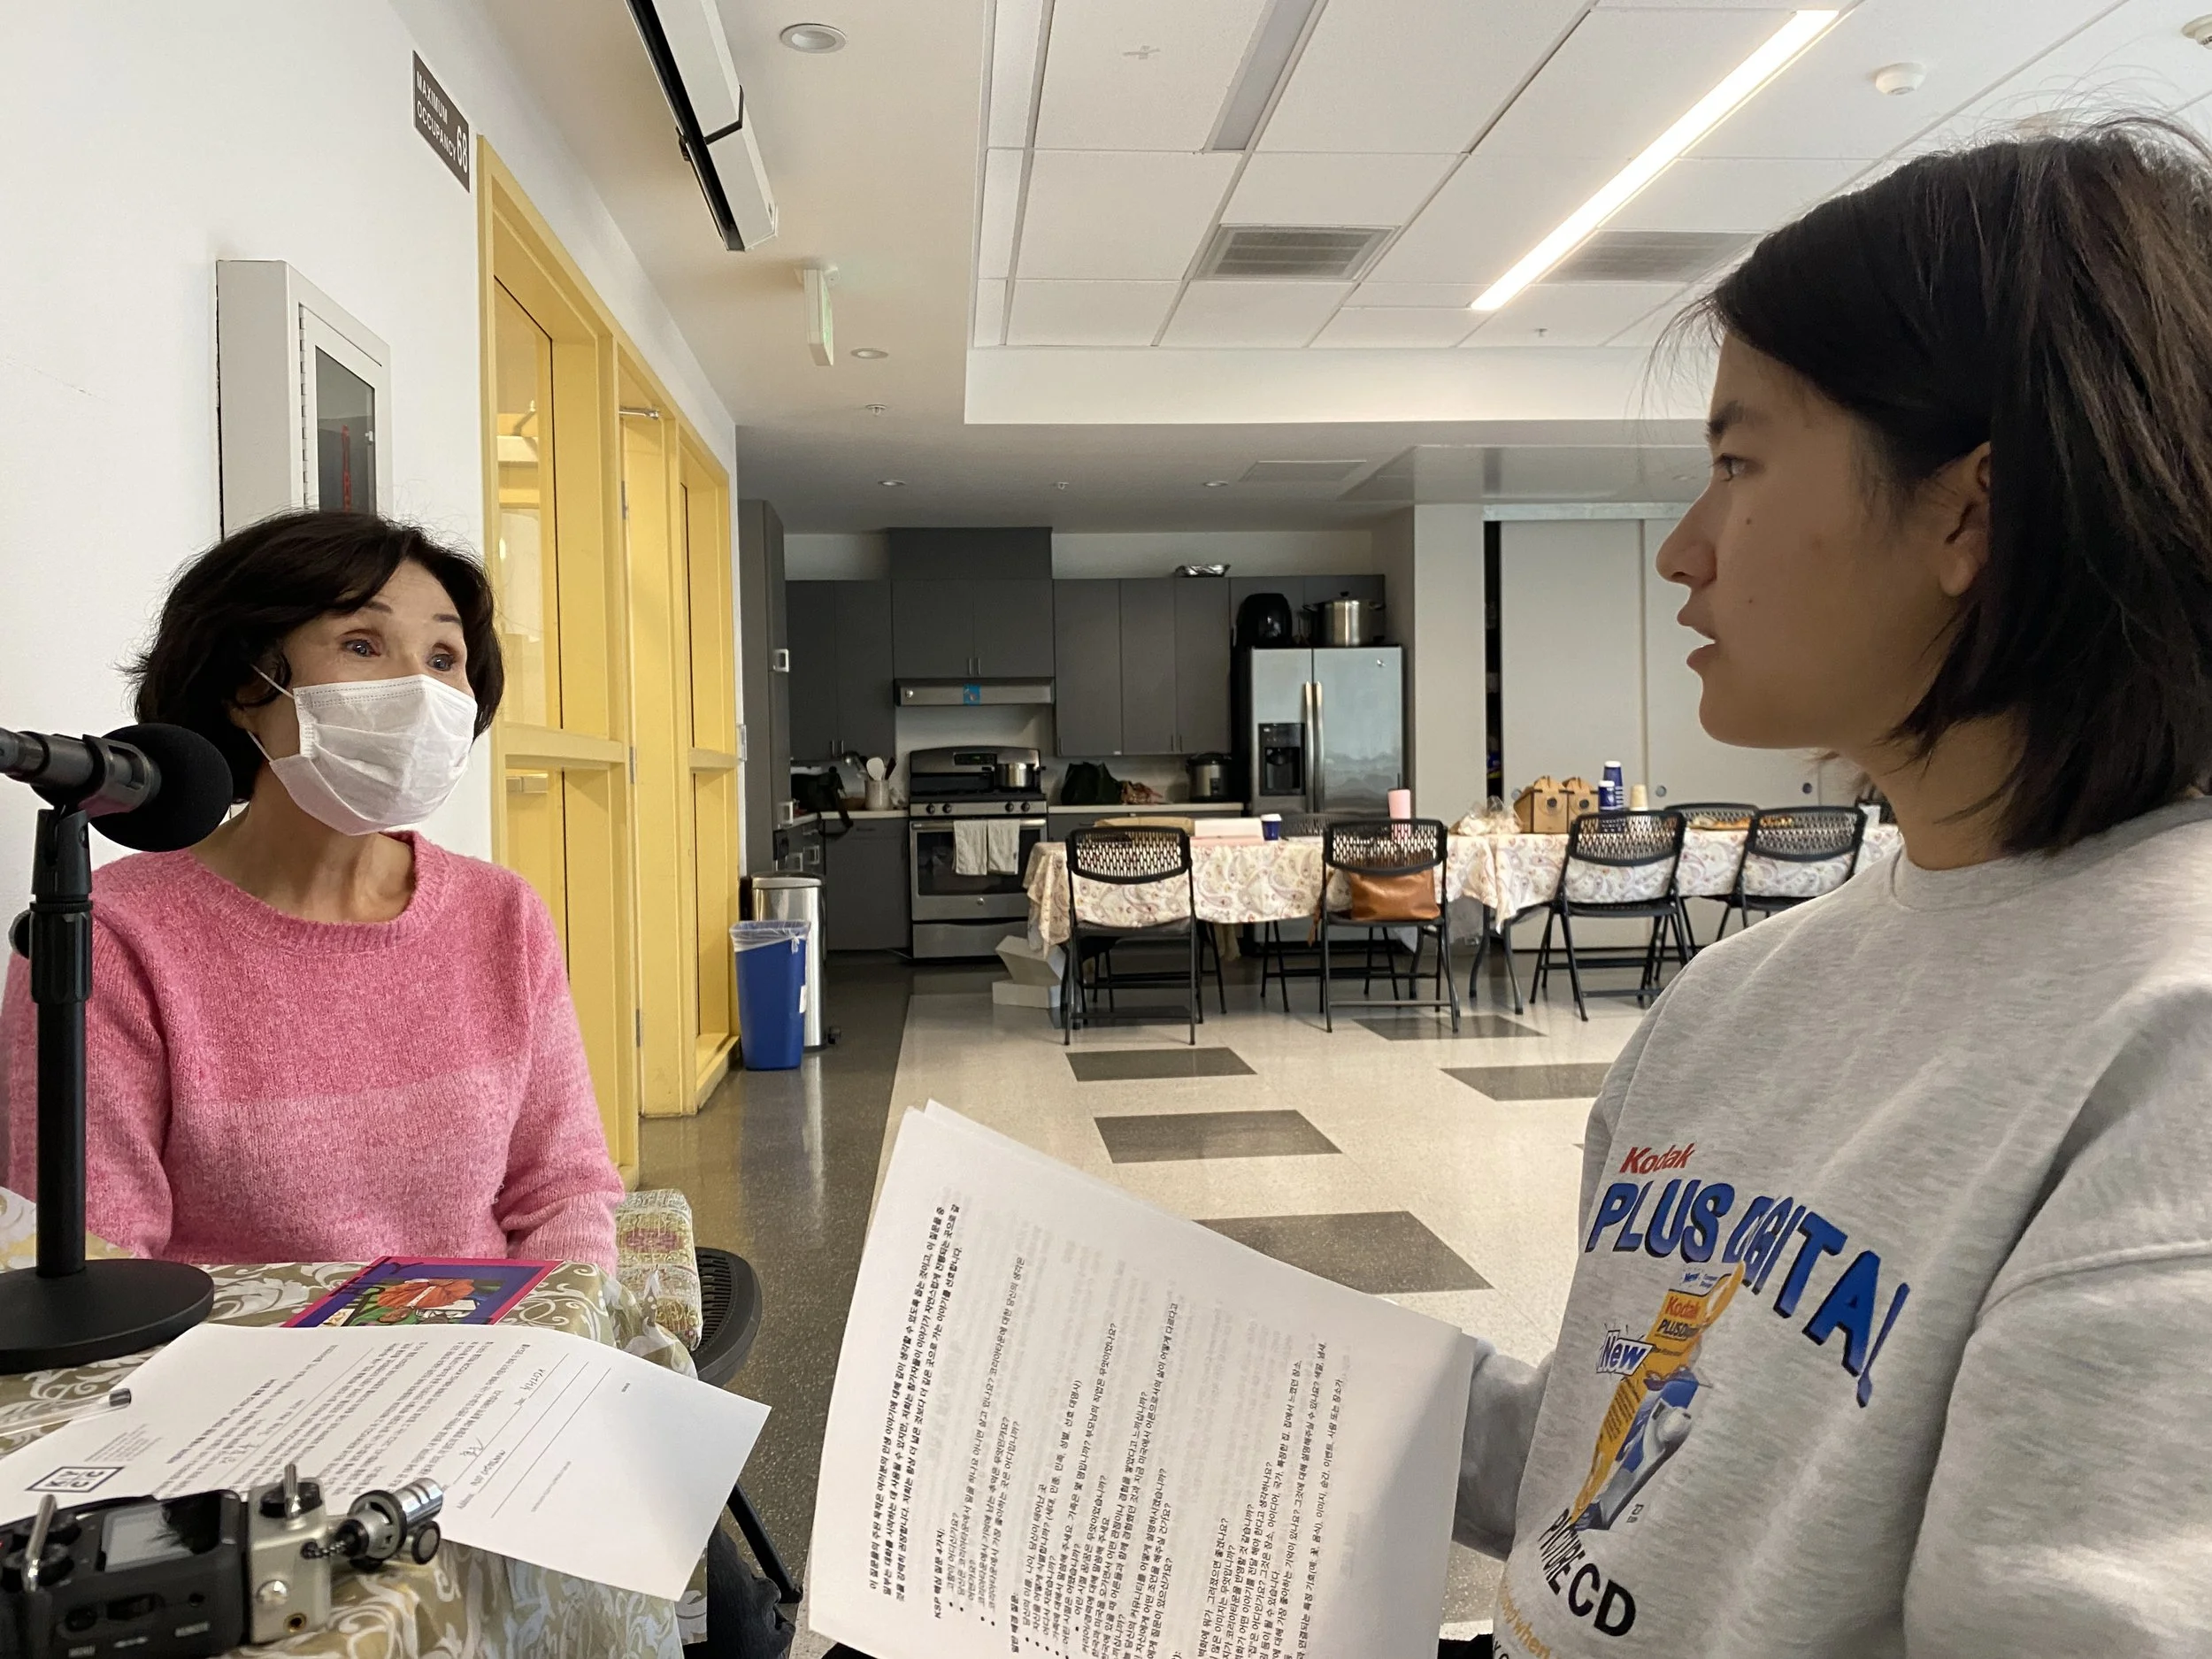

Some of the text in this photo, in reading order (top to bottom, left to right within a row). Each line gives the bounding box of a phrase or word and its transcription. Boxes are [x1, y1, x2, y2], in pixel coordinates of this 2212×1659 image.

[417, 71, 448, 124] MAXIMUM
[417, 99, 468, 173] OCCUPANCY 68
[1620, 1143, 1694, 1174] Kodak
[1585, 1178, 1735, 1263] PLUS
[926, 1240, 936, 1250] 이
[1664, 1296, 1700, 1320] Kodak
[905, 1325, 914, 1334] 수
[888, 1489, 898, 1501] 데
[894, 1451, 903, 1460] 수
[901, 1393, 913, 1419] 저희는
[916, 1314, 931, 1348] 이야기가
[943, 1214, 956, 1239] 곳으로
[899, 1334, 911, 1360] 생각할
[1601, 1333, 1647, 1371] New
[895, 1361, 906, 1379] 깊이
[891, 1380, 902, 1399] 대해
[972, 1325, 1008, 1455] 아니면 살고 있나요? 코리아타운에
[1309, 1380, 1319, 1410] 있나요?
[1332, 1379, 1343, 1403] 장소가
[885, 1399, 898, 1434] 이야기에
[902, 1323, 942, 1503] 저희는 항상 더 것보다 더 깊은 곳으로 가는
[1064, 1409, 1074, 1427] 선호
[1067, 1493, 1079, 1520] 가족은
[1076, 1440, 1090, 1479] 명입니까?
[1092, 1378, 1105, 1402] 직업은
[1099, 1322, 1117, 1376] 무엇이었나요?
[1307, 1410, 1316, 1420] 수
[1329, 1404, 1340, 1421] 또는
[1326, 1421, 1337, 1439] 사람
[1000, 1420, 1019, 1489] 곳은 어디입니까?
[1137, 1429, 1152, 1464] 미국에서
[876, 1455, 888, 1491] 여러분의
[1133, 1465, 1144, 1484] 지금
[1297, 1463, 1308, 1480] 대해
[1037, 1483, 1048, 1494] 곳
[1129, 1485, 1141, 1503] 것과
[1294, 1481, 1305, 1508] 그것에
[1033, 1494, 1045, 1522] 태어난
[1094, 1391, 1148, 1628] 미국을 오가면서 어떤 관점이나 경험을 느끼십니까?
[1121, 1504, 1136, 1540] 경험했던
[1158, 1502, 1171, 1534] 건가요?
[1251, 1579, 1265, 1630] 어디인가요?
[1259, 1551, 1271, 1578] 그것은
[1282, 1403, 1294, 1428] 집에서
[947, 1511, 958, 1562] 어디신가요?
[1028, 1523, 1040, 1550] 당신이
[1214, 1517, 1228, 1557] 좋겠나요?
[1288, 1509, 1300, 1540] 있나요?
[1073, 1474, 1106, 1616] 어린 시절 무엇이었습니까?
[1118, 1541, 1129, 1560] 함께
[1239, 1461, 1272, 1634] 어떤 이야기를 전달 해야 한다고 생각하나요?
[1285, 1541, 1296, 1568] 기억이
[869, 1578, 878, 1589] 이
[1110, 1562, 1124, 1599] 어른들과
[1147, 1565, 1160, 1593] 조언을
[1225, 1503, 1254, 1640] 코리아타운을 반영할 것 같습니까?
[1150, 1556, 1172, 1638] 질문이 있으신가요?
[1210, 1544, 1235, 1654] 않은 이미지는 무엇입니까?
[1279, 1571, 1292, 1605] 좋아하는
[1569, 1563, 1637, 1637] CD
[1108, 1600, 1117, 1611] 때
[1142, 1594, 1154, 1613] 어떤
[1265, 1608, 1274, 1617] 수
[1276, 1607, 1286, 1626] 가장
[1041, 1607, 1050, 1635] 어디서
[1061, 1624, 1070, 1645] 어린
[1103, 1612, 1115, 1632] 있을
[1124, 1620, 1137, 1648] 당신의
[1135, 1615, 1150, 1653] 자신에게
[1297, 1613, 1310, 1648] 연결되는
[1260, 1630, 1271, 1650] 등이
[1273, 1626, 1284, 1647] 대해
